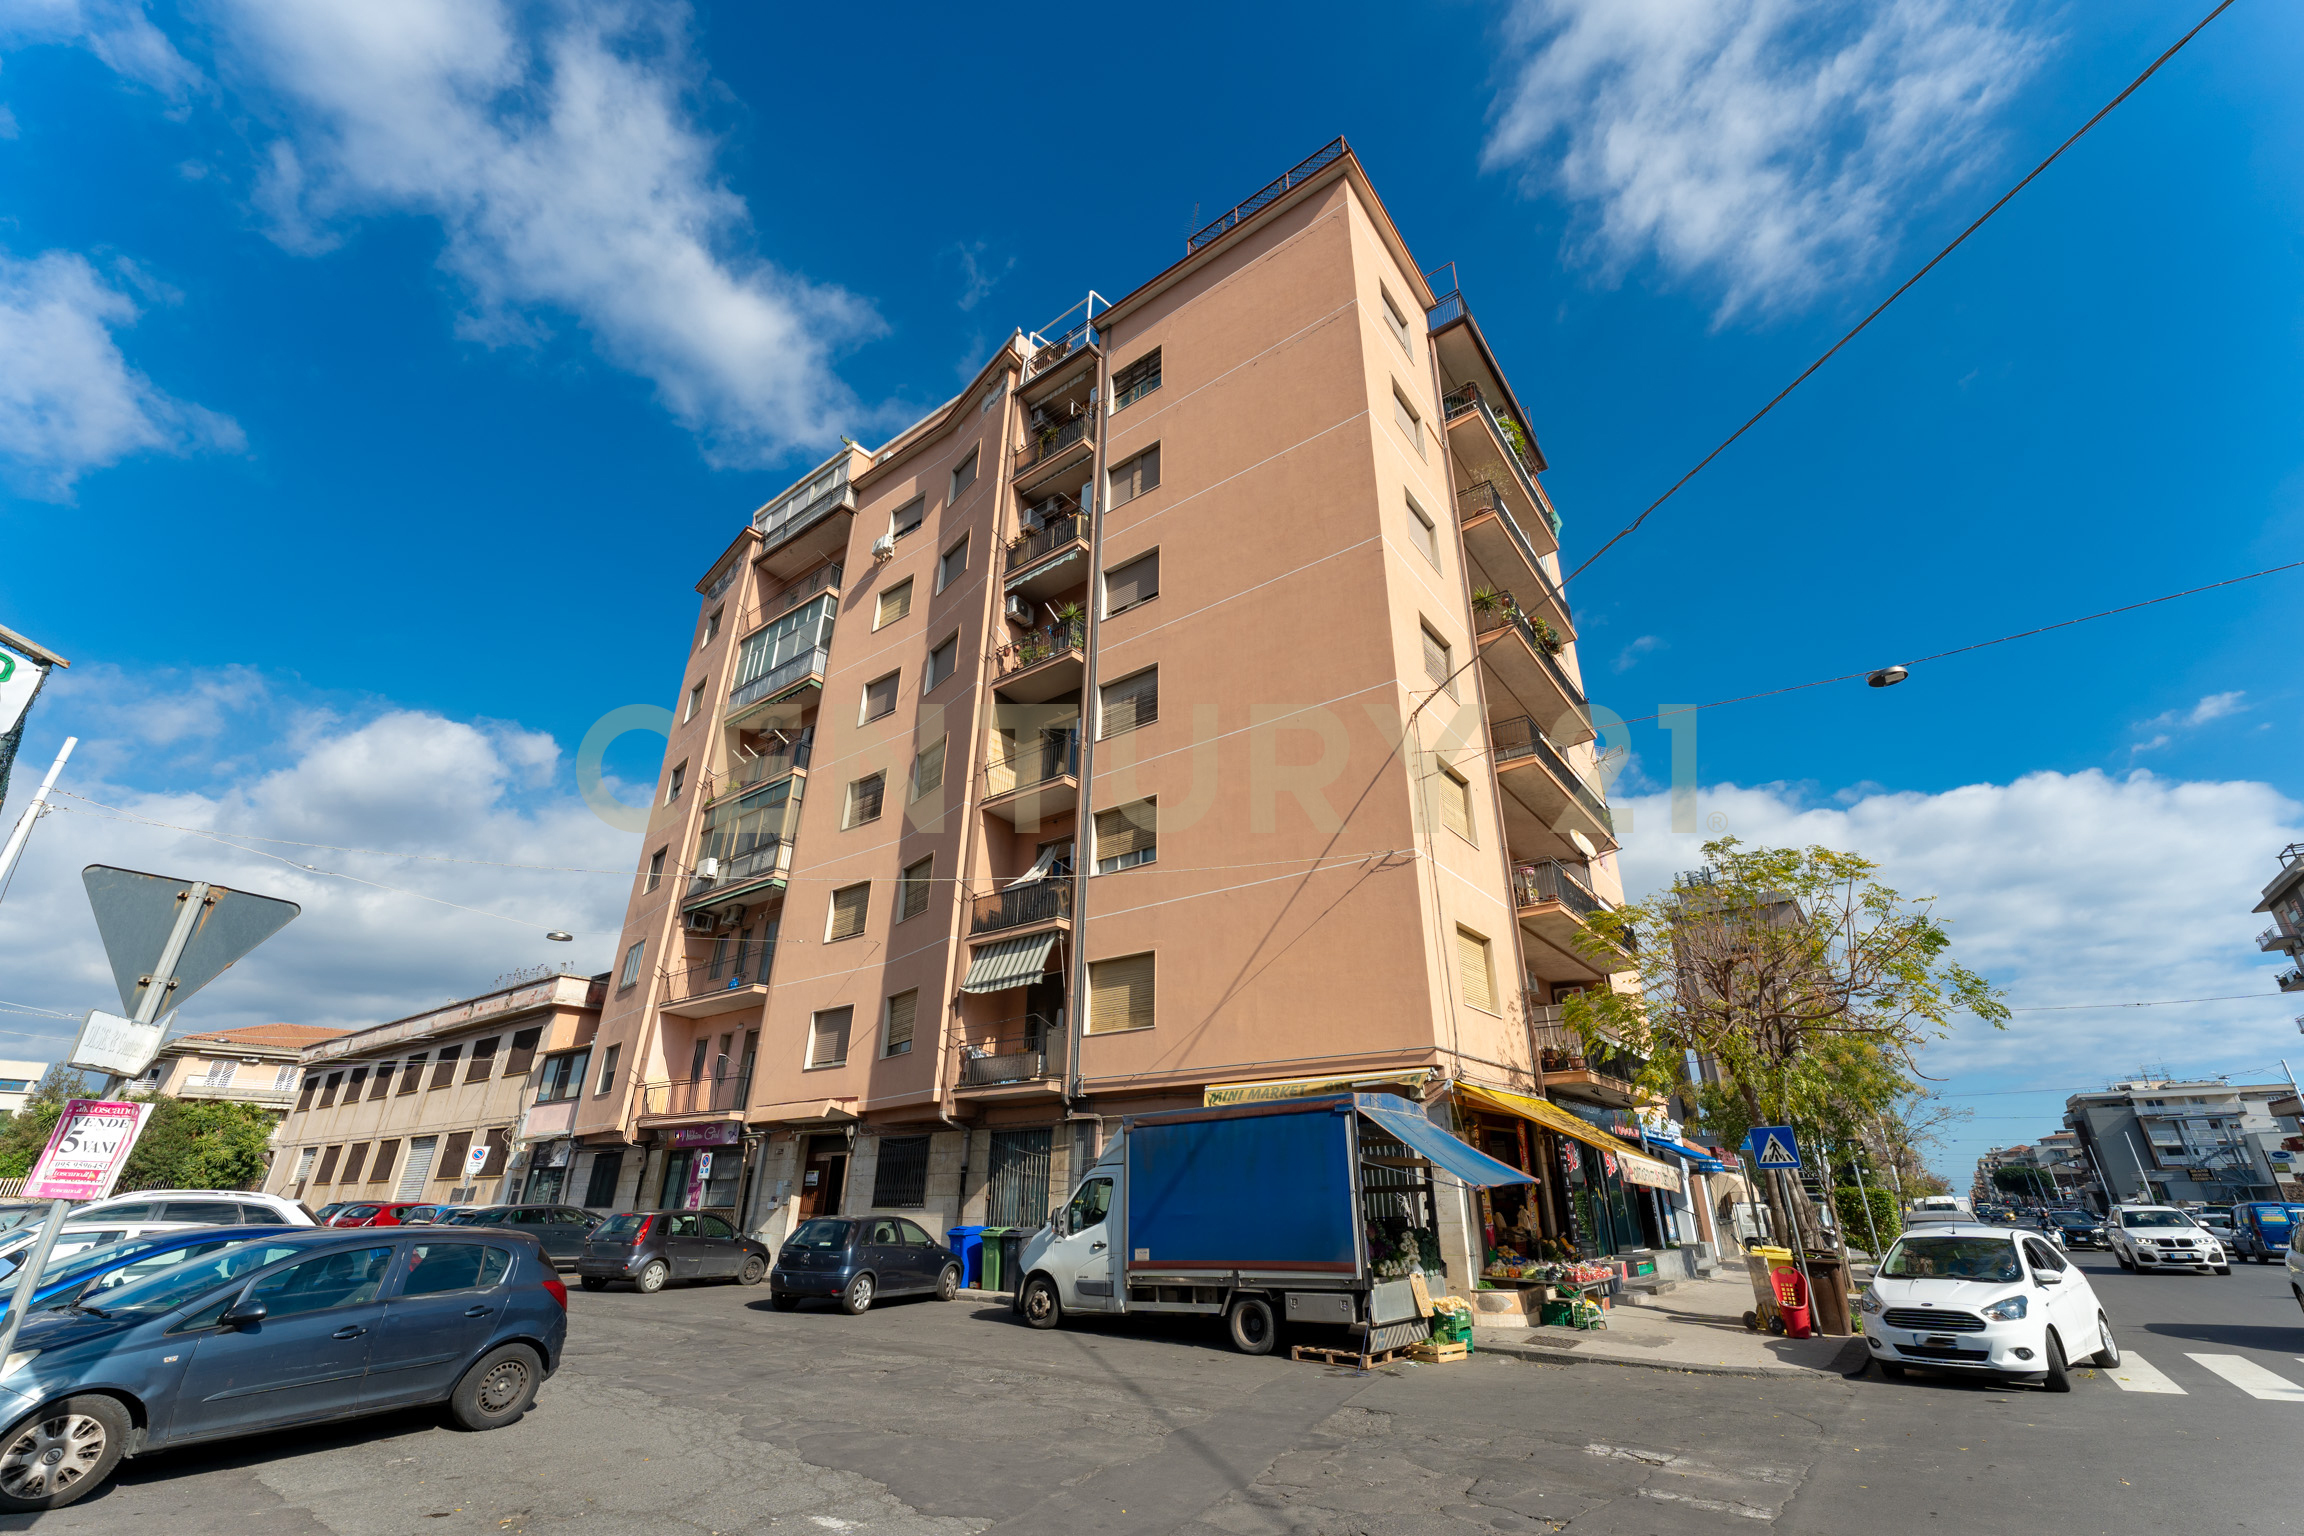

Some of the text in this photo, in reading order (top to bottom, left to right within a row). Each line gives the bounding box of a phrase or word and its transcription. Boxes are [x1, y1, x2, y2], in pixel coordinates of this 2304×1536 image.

[1209, 1089, 1244, 1103] MINI
[1247, 1084, 1307, 1100] MARKET
[90, 1103, 138, 1116] toscano
[74, 1117, 129, 1129] VENDE
[59, 1130, 118, 1154] 5 VANI
